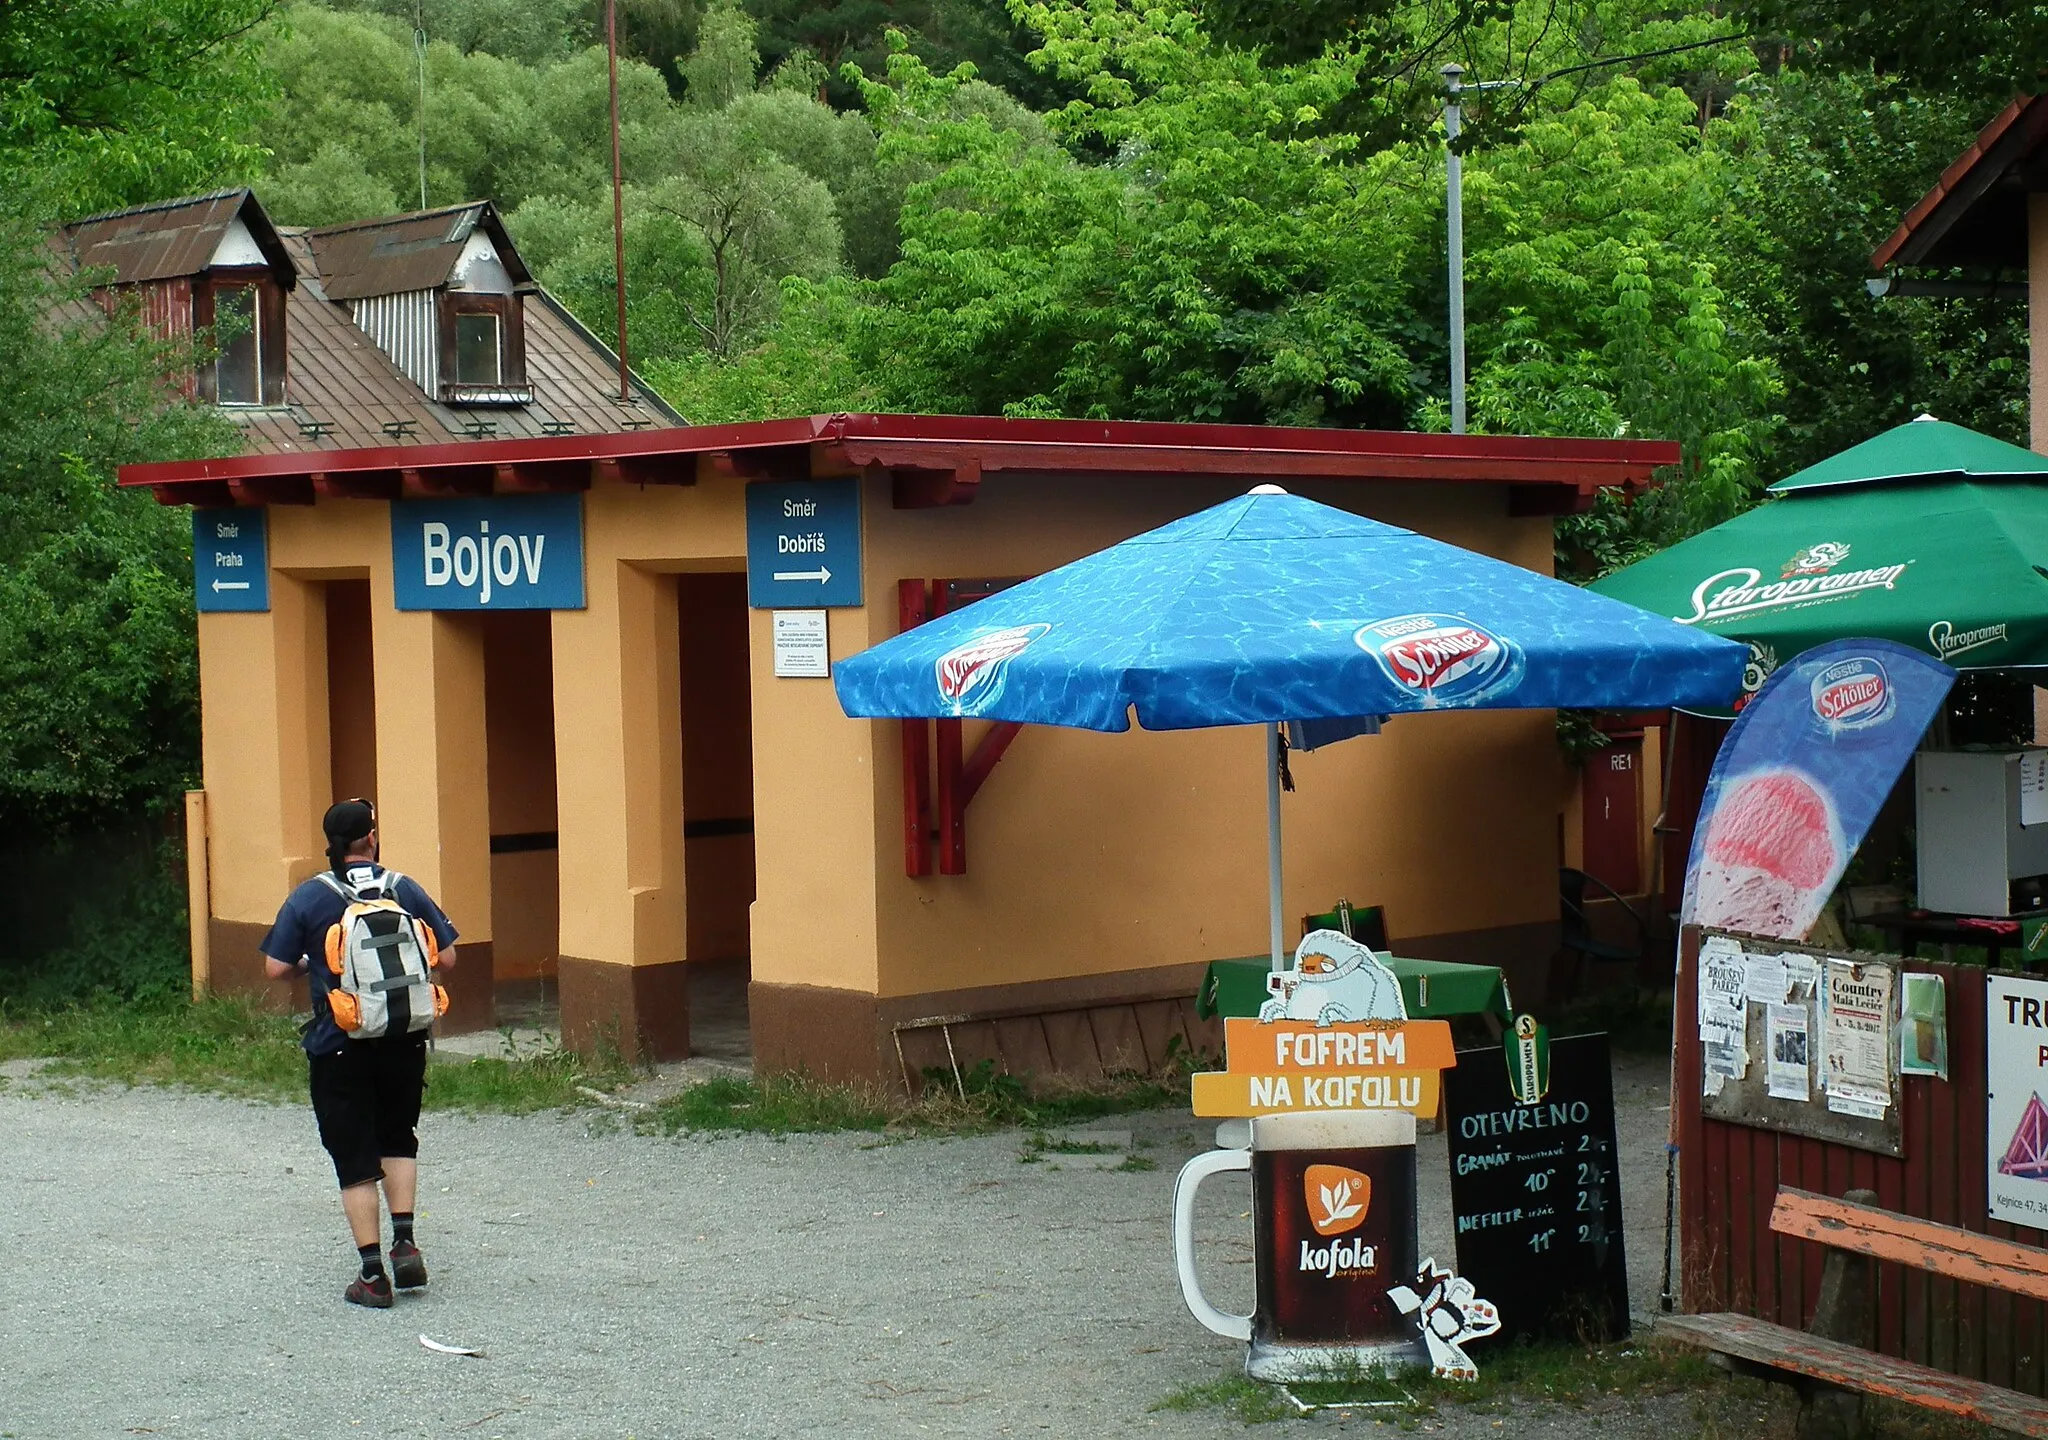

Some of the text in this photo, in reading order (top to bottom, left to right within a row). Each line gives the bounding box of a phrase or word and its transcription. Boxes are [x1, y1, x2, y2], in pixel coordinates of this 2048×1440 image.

[782, 498, 817, 518] Směr
[216, 523, 239, 539] Směr
[778, 532, 826, 554] Dobříš
[215, 551, 243, 567] Praha
[423, 520, 545, 604] Bojov
[1672, 561, 1906, 625] Staropramen
[1929, 620, 2008, 662] Staropramen
[1390, 630, 1485, 688] Schöller
[1821, 679, 1879, 718] Schöller
[1711, 979, 1740, 995] PARKET
[1832, 977, 1884, 999] Country
[1276, 1032, 1406, 1067] FOFREM
[1526, 1041, 1537, 1103] STAROPRAMEN
[1250, 1076, 1421, 1108] NA KOFOLU
[1300, 1237, 1375, 1279] kofola
